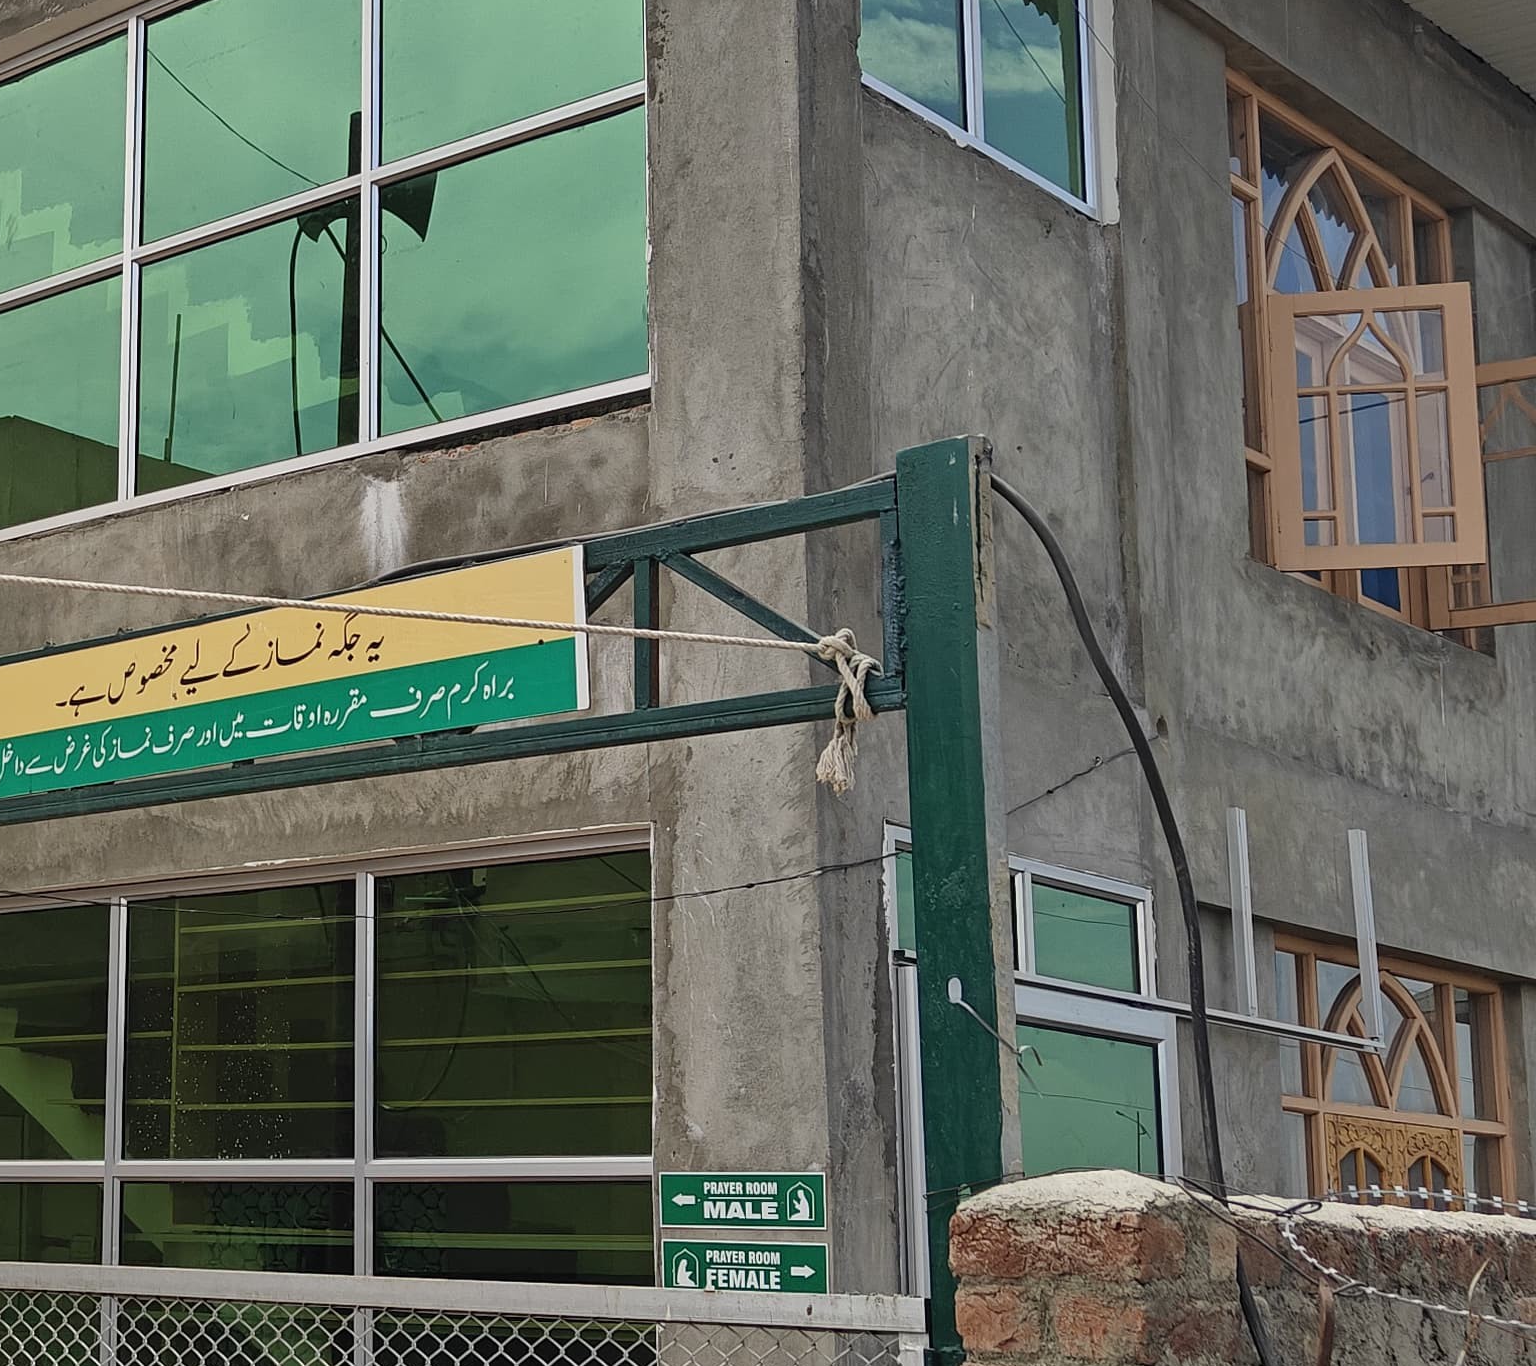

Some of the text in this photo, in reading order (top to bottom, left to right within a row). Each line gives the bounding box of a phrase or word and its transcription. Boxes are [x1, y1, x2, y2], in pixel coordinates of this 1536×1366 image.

[222, 622, 261, 677] کے
[262, 622, 326, 671] نماز
[328, 612, 361, 662] جگہ
[365, 635, 385, 663] یہ
[107, 644, 178, 705] مخصوص
[447, 660, 489, 721] کرم
[483, 674, 514, 700] براہ
[324, 688, 368, 731] مقررہ
[369, 686, 446, 719] صرف
[196, 722, 216, 747] اور
[220, 711, 245, 747] میں
[246, 704, 322, 738] اوقات
[53, 734, 92, 774] غرض
[92, 725, 113, 768] کی
[108, 727, 152, 761] نماز
[152, 724, 196, 756] صرف
[25, 754, 53, 775] سے
[703, 1181, 778, 1196] PRAYER ROOM
[703, 1201, 779, 1220] MALE
[705, 1249, 781, 1265] PRAYER ROOM
[705, 1268, 781, 1290] FEMALE
